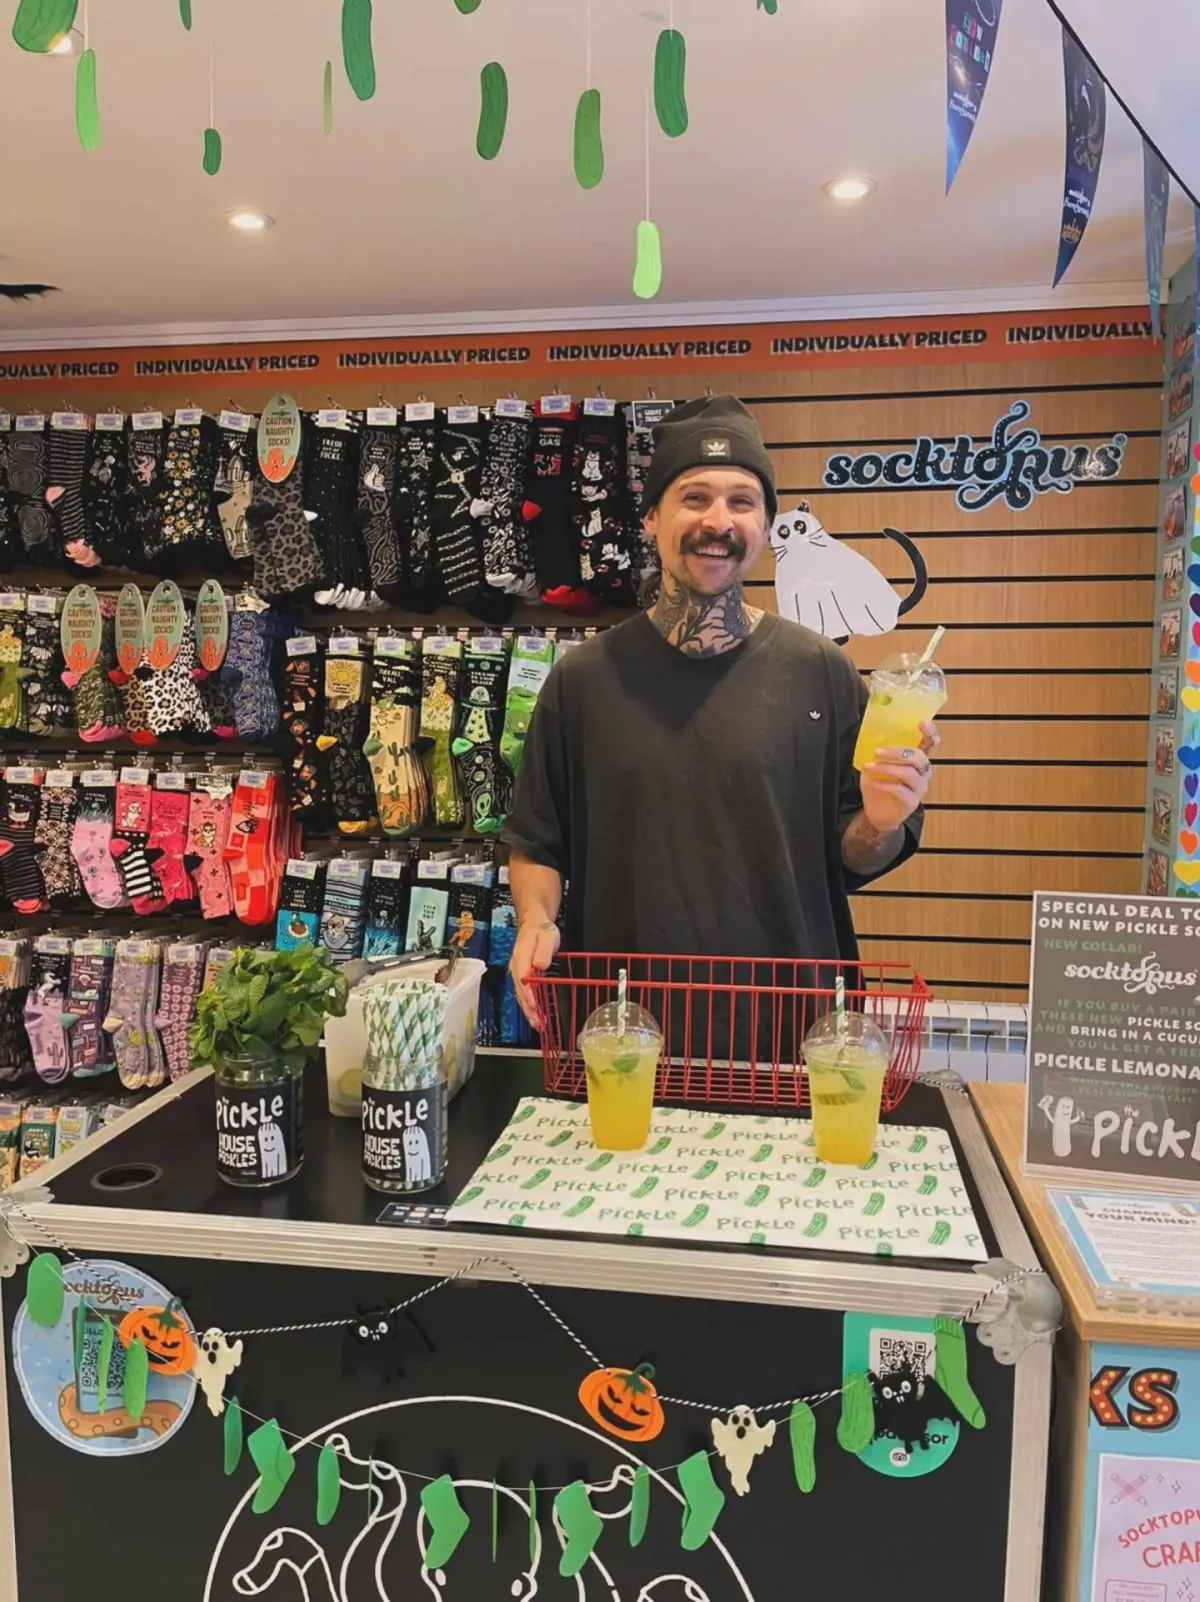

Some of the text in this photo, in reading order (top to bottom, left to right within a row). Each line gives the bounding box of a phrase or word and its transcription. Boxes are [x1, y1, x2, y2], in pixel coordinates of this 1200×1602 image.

[60, 361, 119, 378] PRICED
[135, 357, 255, 375] INDIVIDUALLY
[257, 354, 320, 371] PRICED
[337, 350, 462, 368] INDIVIDUALLY
[464, 347, 530, 365] PRICED
[547, 342, 679, 361] INDIVIDUALLY
[682, 340, 752, 358] PRICED
[771, 332, 911, 355] INDIVIDUALLY
[913, 329, 987, 350] PRICED
[539, 438, 561, 447] GAS
[1041, 901, 1119, 916] SPECIAL
[1125, 905, 1175, 920] DEAL
[1038, 917, 1063, 929] ON
[1069, 919, 1110, 931] NEW
[1115, 922, 1179, 936] PICKLE
[1044, 938, 1143, 954] NEW COLLAB!
[1064, 951, 1197, 995] socktopus
[1075, 999, 1105, 1010] YOU
[1110, 1002, 1140, 1014] BUY
[1160, 1006, 1197, 1017] PAIR
[1040, 1010, 1087, 1021] THESE
[1090, 1013, 1123, 1025] NEW
[1127, 1017, 1181, 1030] PICKLE
[1035, 1023, 1066, 1034] AND
[1070, 1025, 1118, 1038] BRING
[1122, 1029, 1138, 1040] IN
[1143, 1031, 1153, 1041] A
[1123, 1043, 1151, 1054] GET
[1034, 1052, 1107, 1071] PICKLE
[1124, 1105, 1140, 1118] the
[537, 1117, 592, 1127] Pickl
[649, 1125, 699, 1134] ickle
[218, 1132, 256, 1153] HOUSE
[364, 1133, 400, 1156] HOUSE
[218, 1151, 258, 1168] PICKLES
[363, 1151, 402, 1170] PICKLES
[1084, 1211, 1136, 1221] YOUR
[64, 1272, 145, 1305] ocktopus
[1117, 1508, 1200, 1549] SOCKTOP
